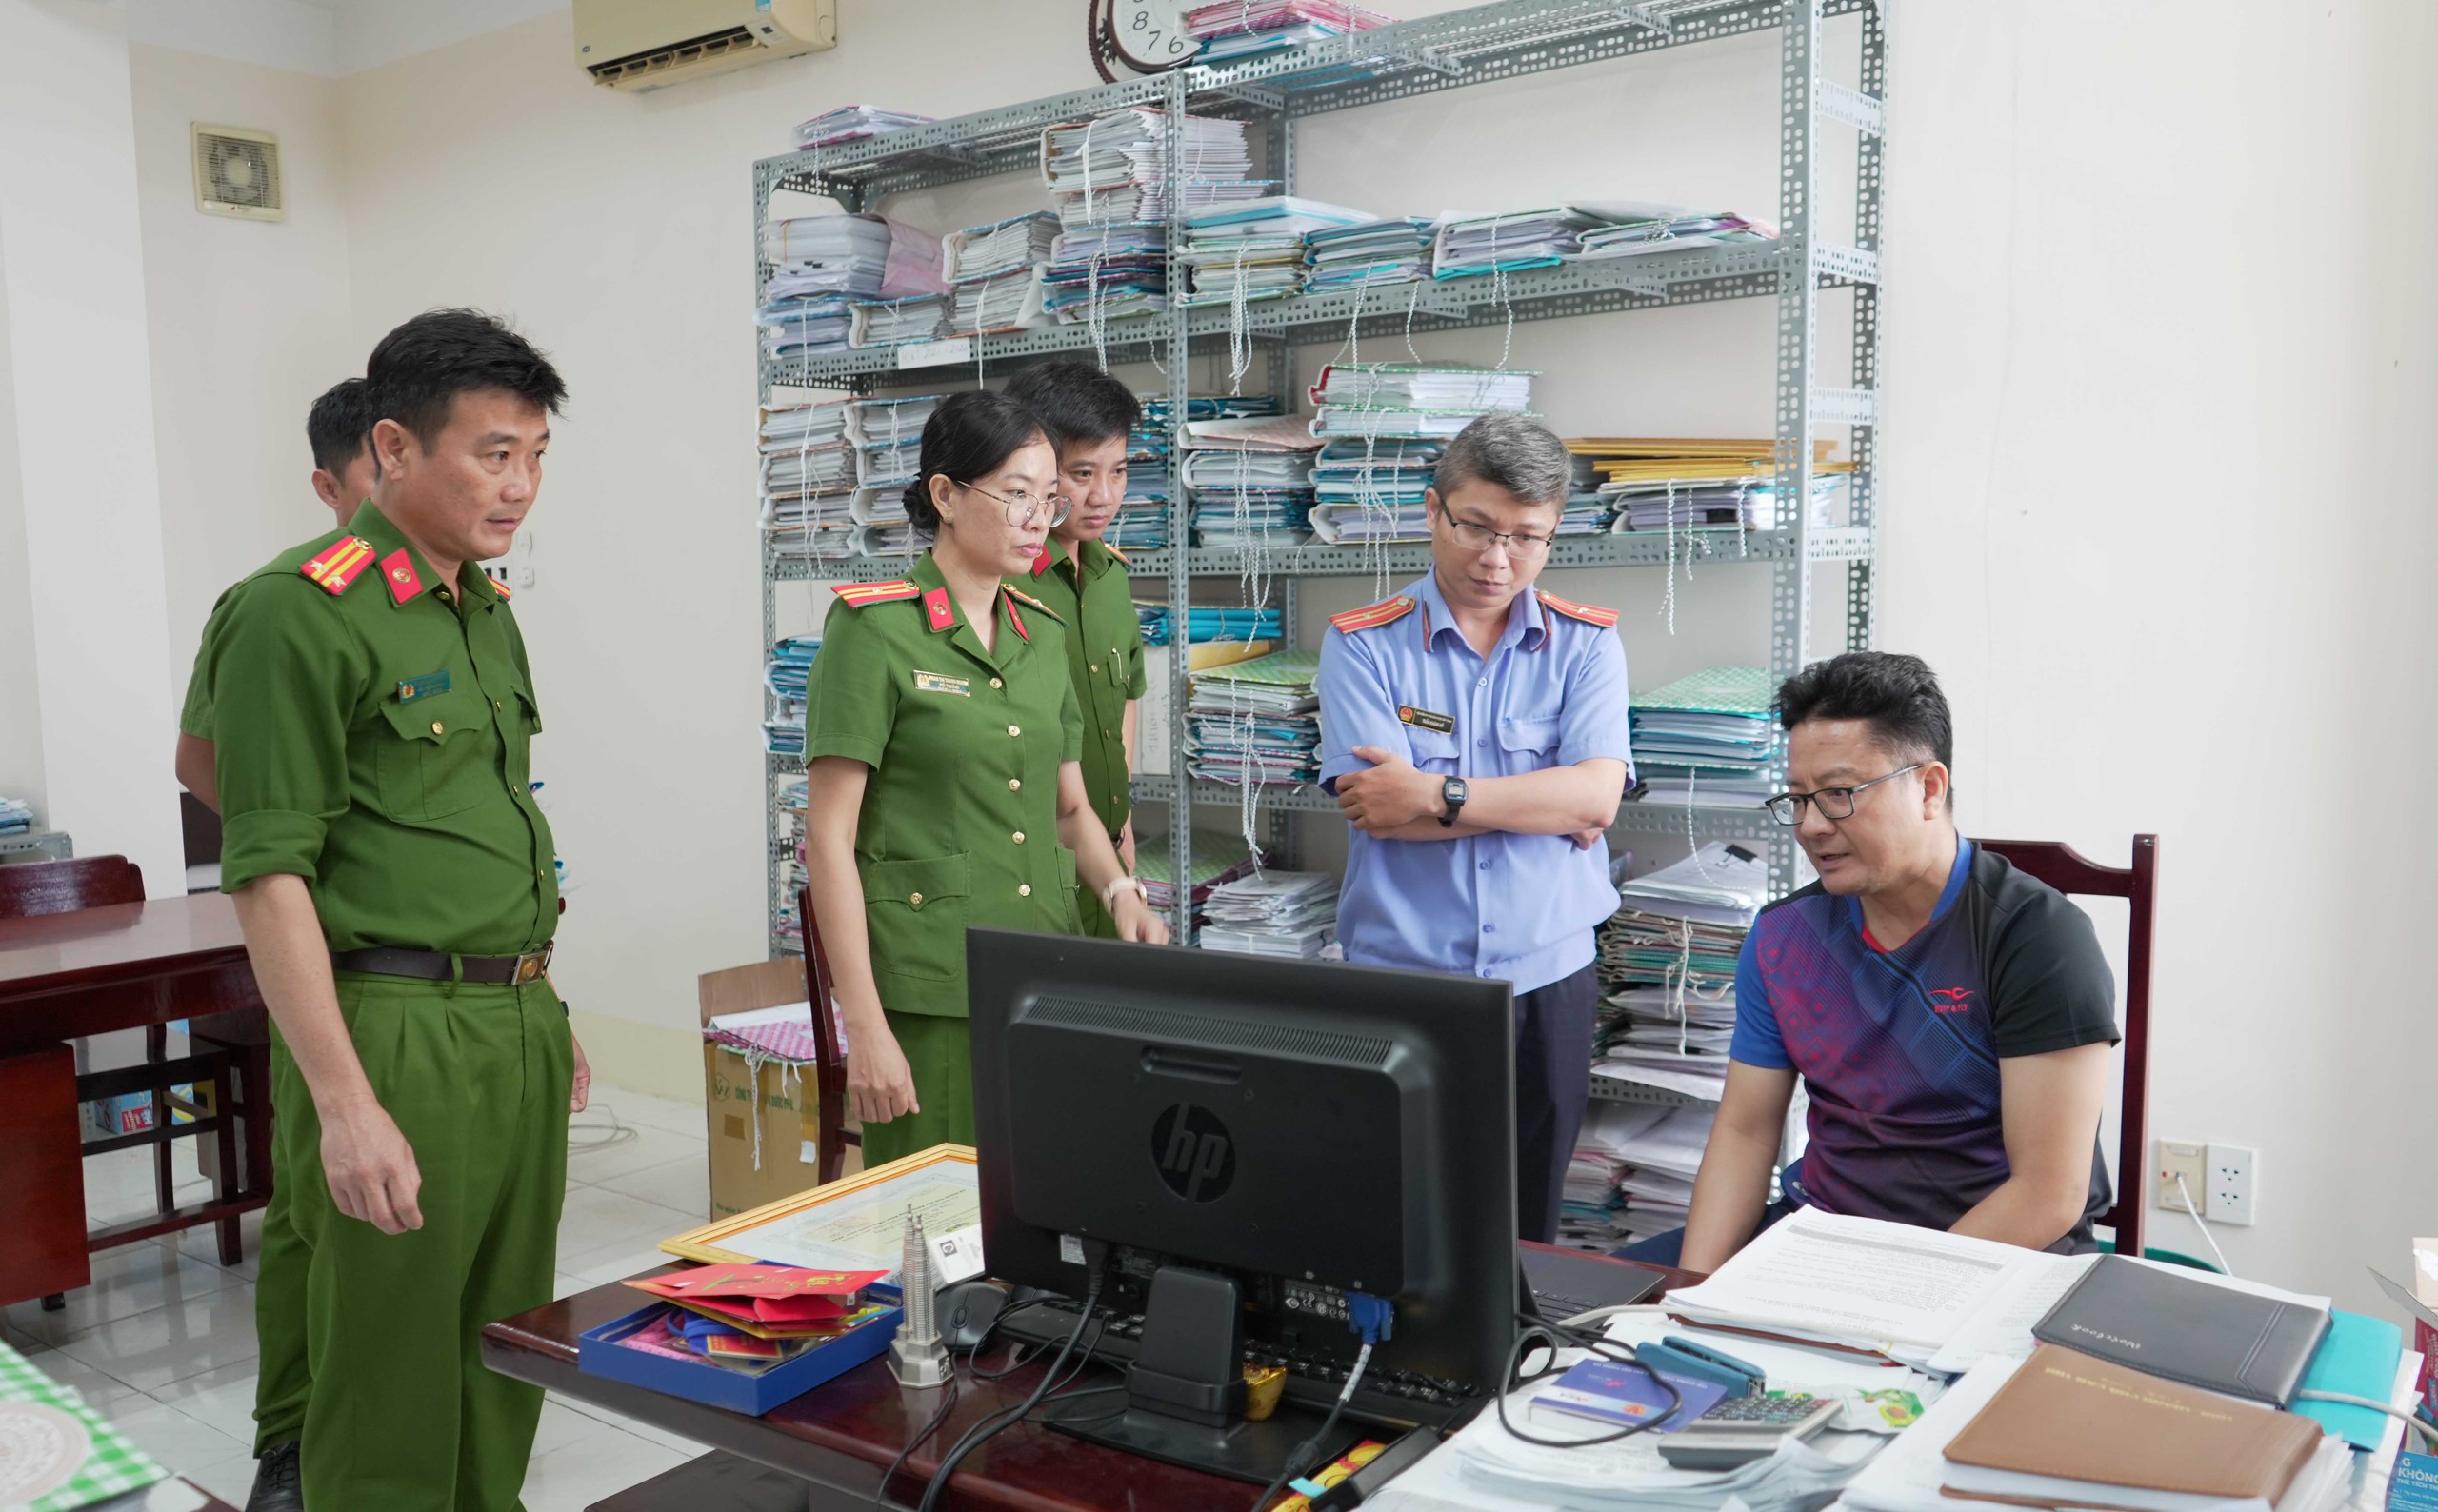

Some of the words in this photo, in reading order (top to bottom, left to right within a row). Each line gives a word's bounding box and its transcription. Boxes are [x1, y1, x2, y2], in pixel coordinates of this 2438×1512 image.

[1132, 10, 1149, 30] 8
[1149, 30, 1161, 50] 7
[1169, 35, 1184, 54] 6
[1162, 1102, 1228, 1203] hp
[2402, 1457, 2411, 1467] G
